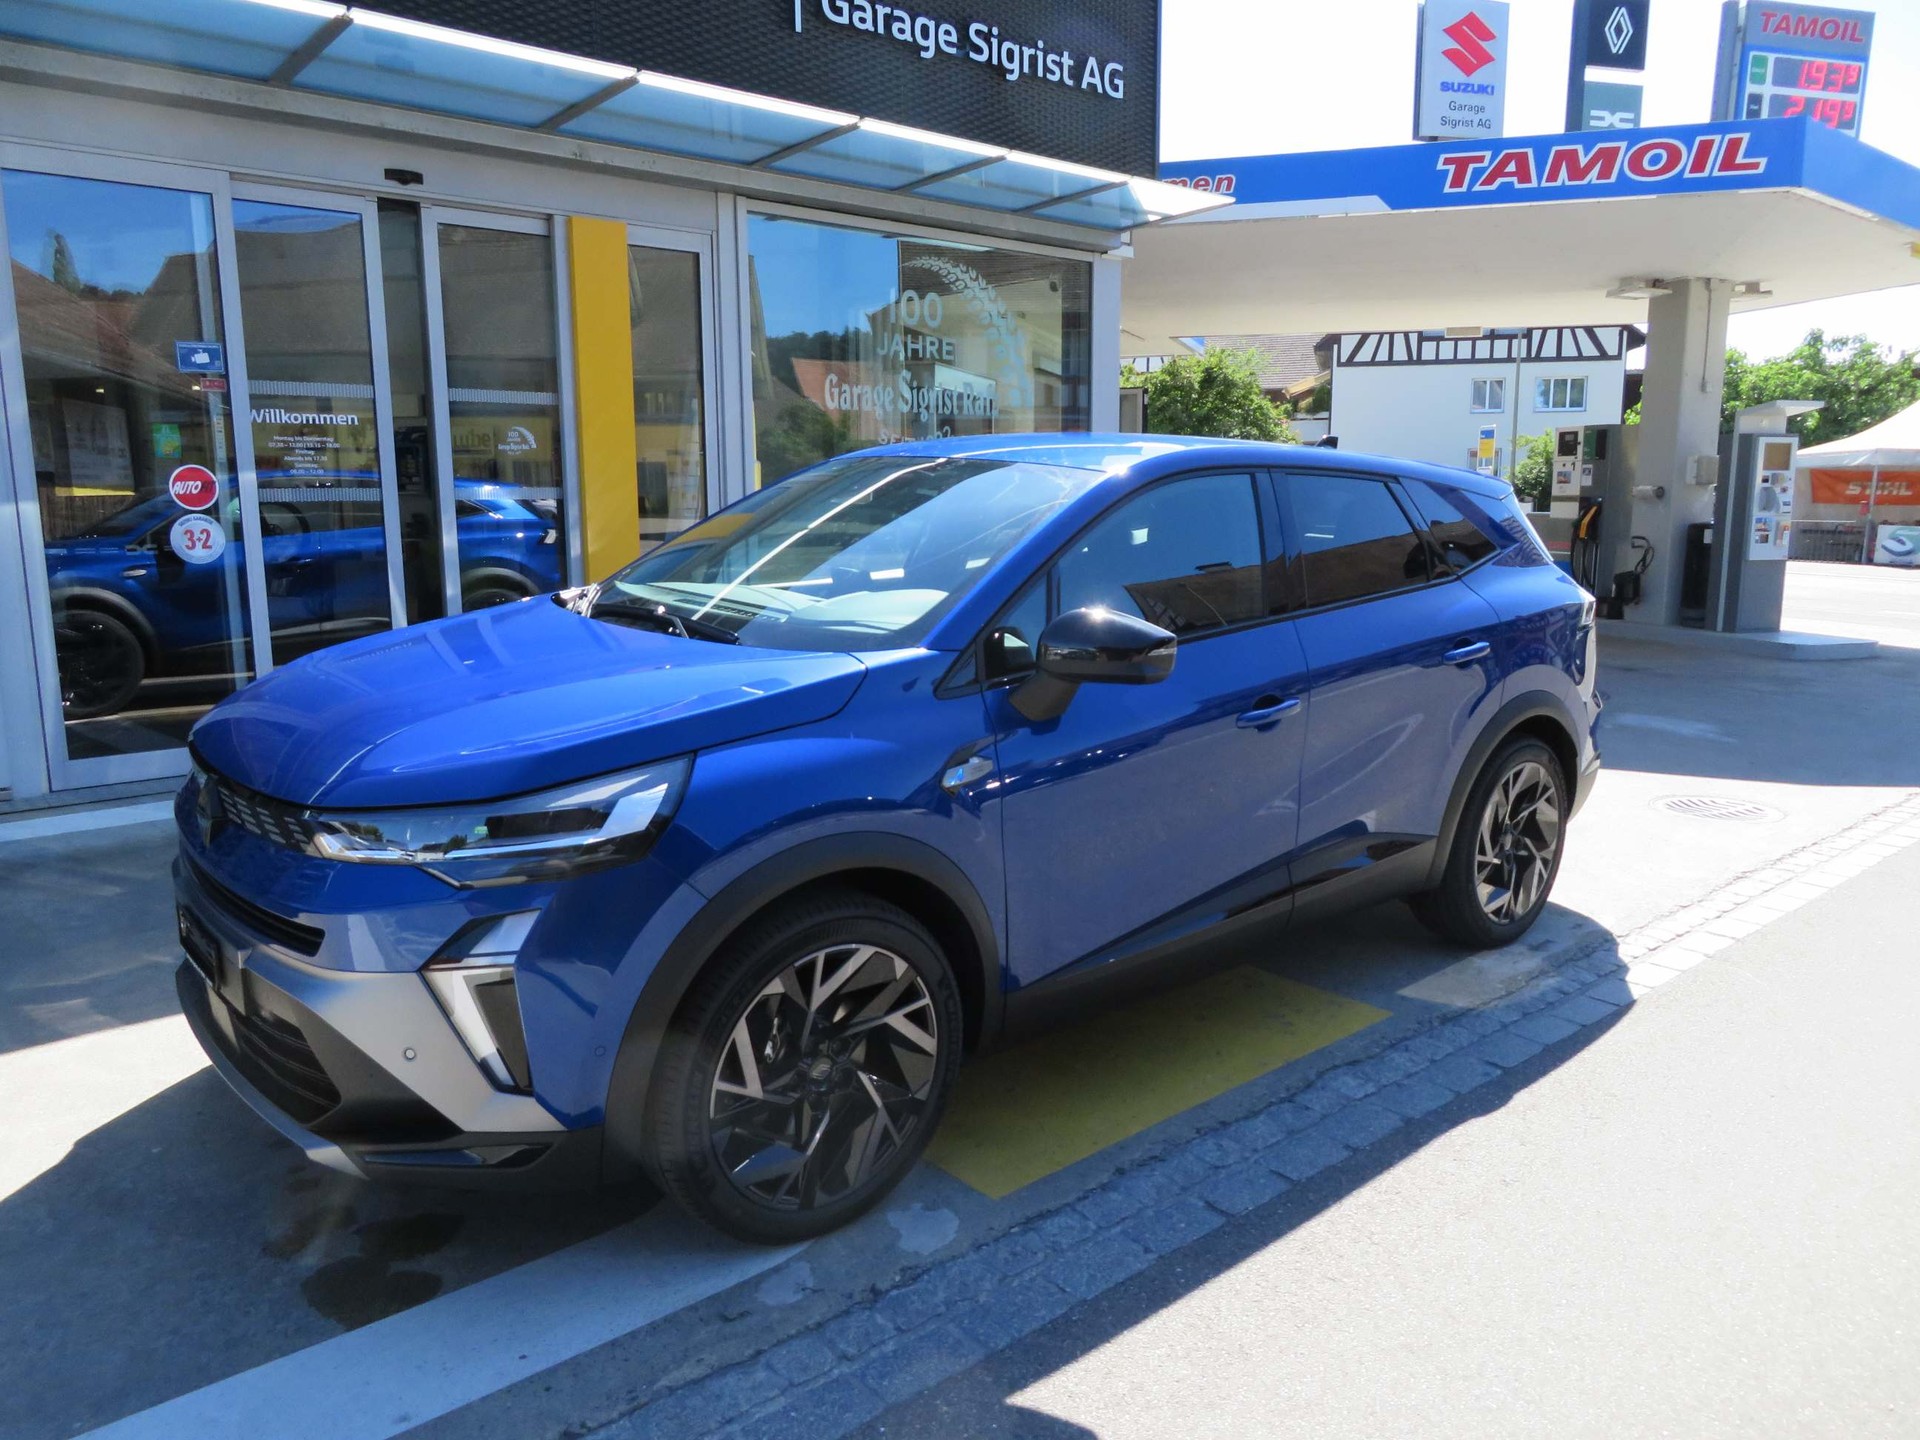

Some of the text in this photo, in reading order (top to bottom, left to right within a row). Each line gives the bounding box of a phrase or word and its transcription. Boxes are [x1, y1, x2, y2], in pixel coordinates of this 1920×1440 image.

[1760, 11, 1865, 43] TAMOIL
[821, 0, 1124, 99] Garage Sigrist AG
[1439, 81, 1495, 96] SUZUKI
[1440, 116, 1492, 129] Sigrist AG
[1448, 100, 1486, 114] Garage
[1436, 132, 1768, 193] TAMOIL
[889, 287, 944, 329] 100
[876, 330, 956, 362] JAHRE
[824, 372, 895, 422] Garage
[899, 368, 959, 423] Sigrist
[250, 408, 359, 426] Willkommen
[183, 528, 213, 551] 3+2
